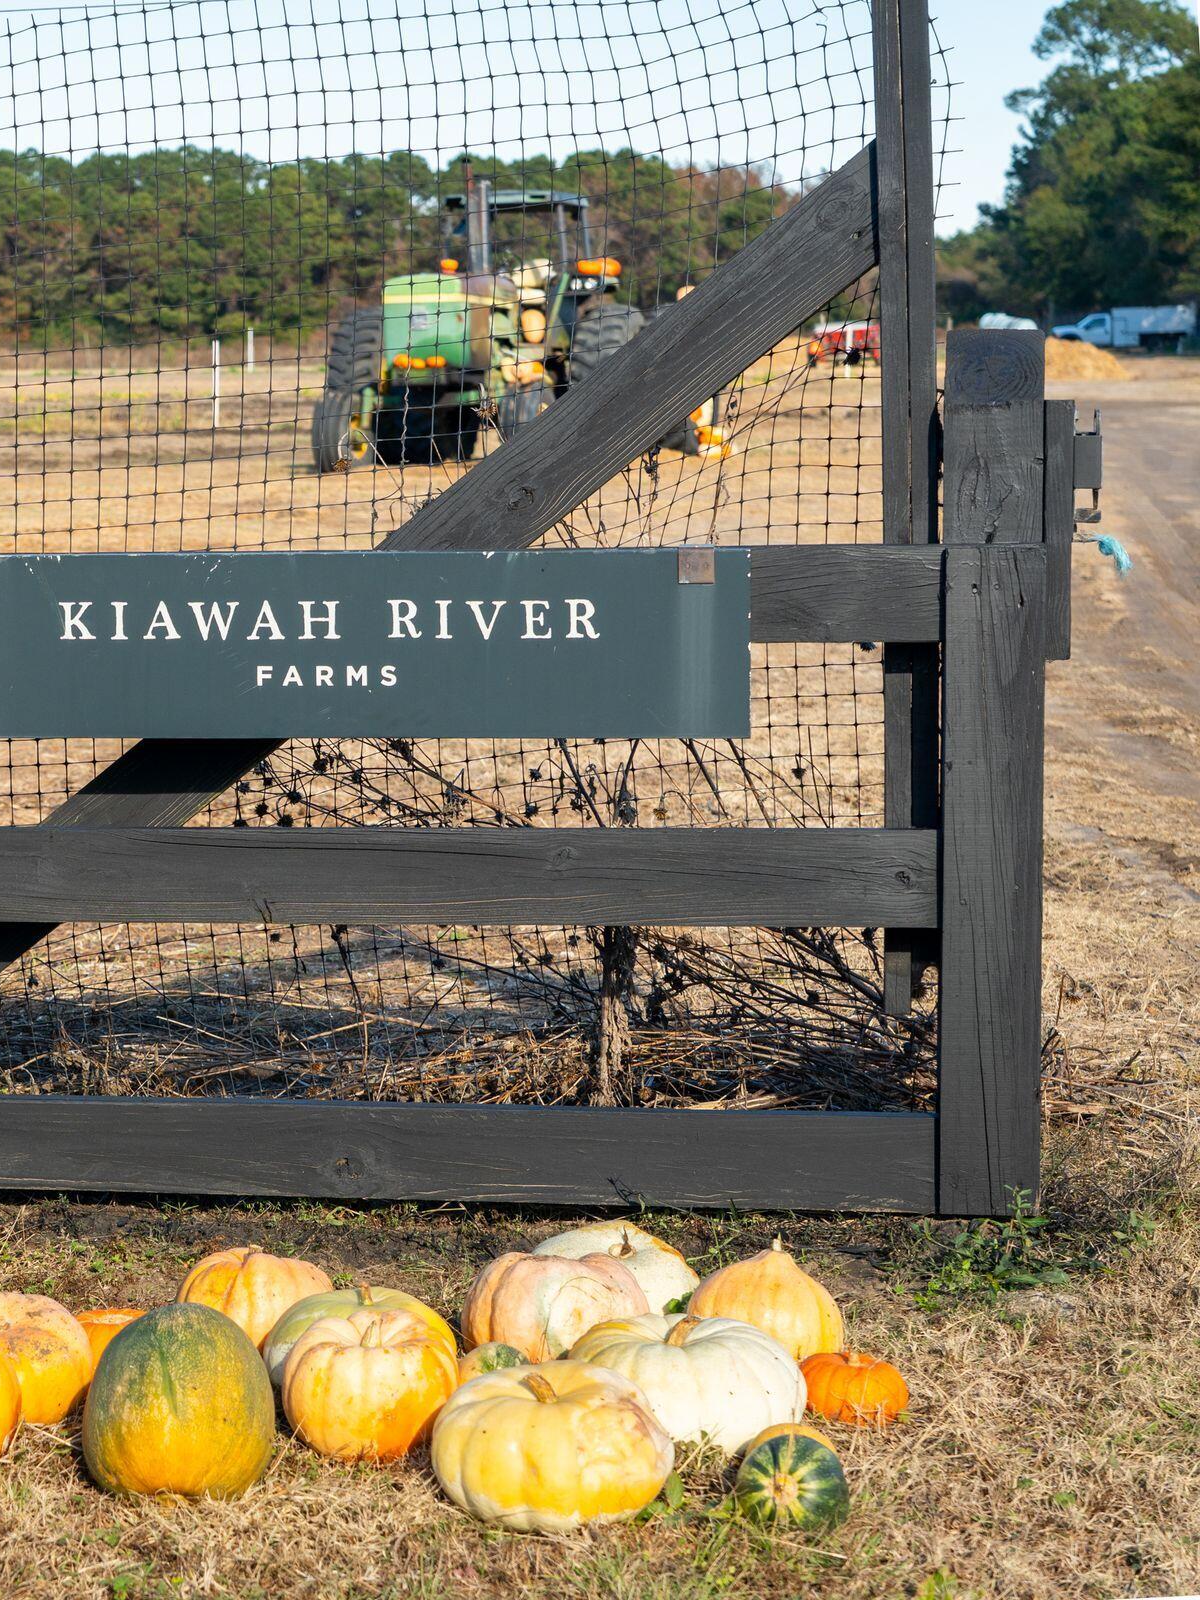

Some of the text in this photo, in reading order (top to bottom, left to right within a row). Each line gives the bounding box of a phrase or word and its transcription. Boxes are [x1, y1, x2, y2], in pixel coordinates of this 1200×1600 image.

[58, 598, 601, 642] KIAWAH RIVER
[256, 664, 398, 688] FARMS
